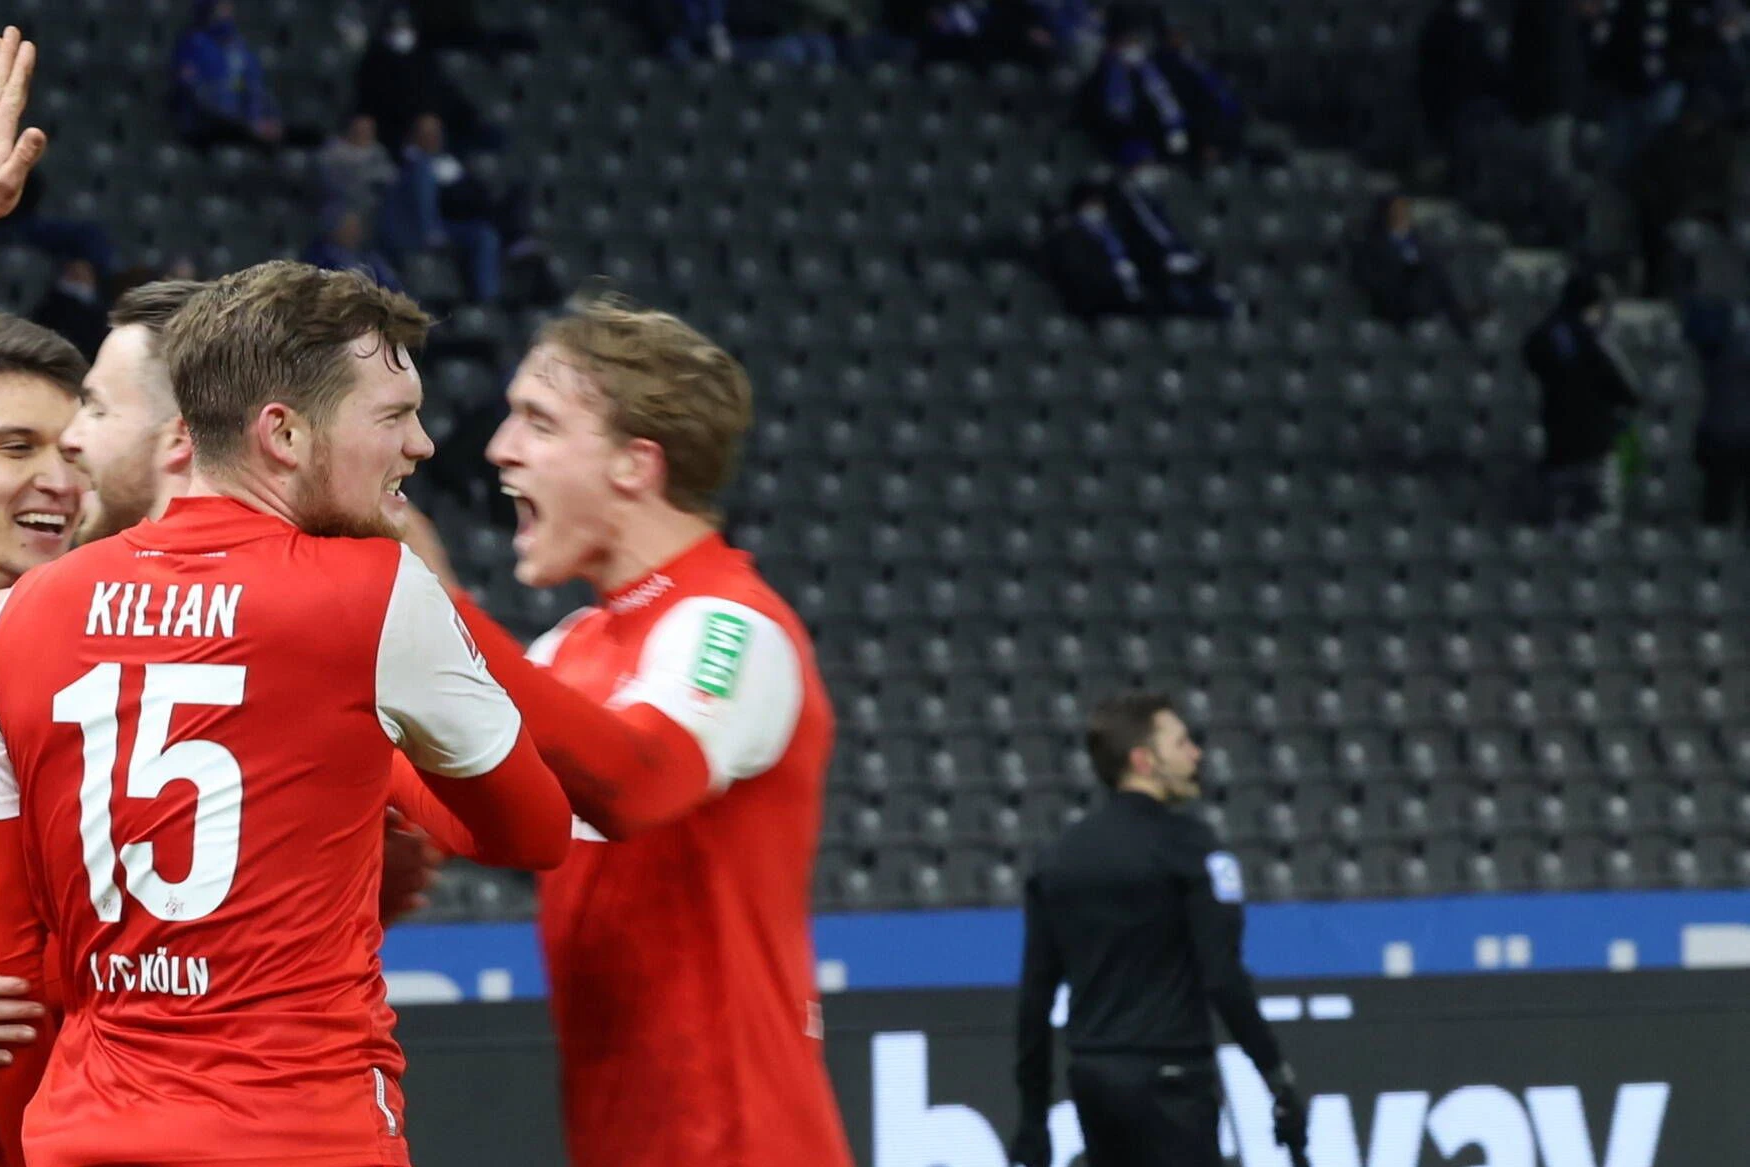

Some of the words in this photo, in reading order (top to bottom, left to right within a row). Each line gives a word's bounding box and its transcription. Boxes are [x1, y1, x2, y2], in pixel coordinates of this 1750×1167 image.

[85, 581, 243, 638] KILIAN
[52, 662, 248, 922] 15
[138, 946, 209, 996] KÖLN
